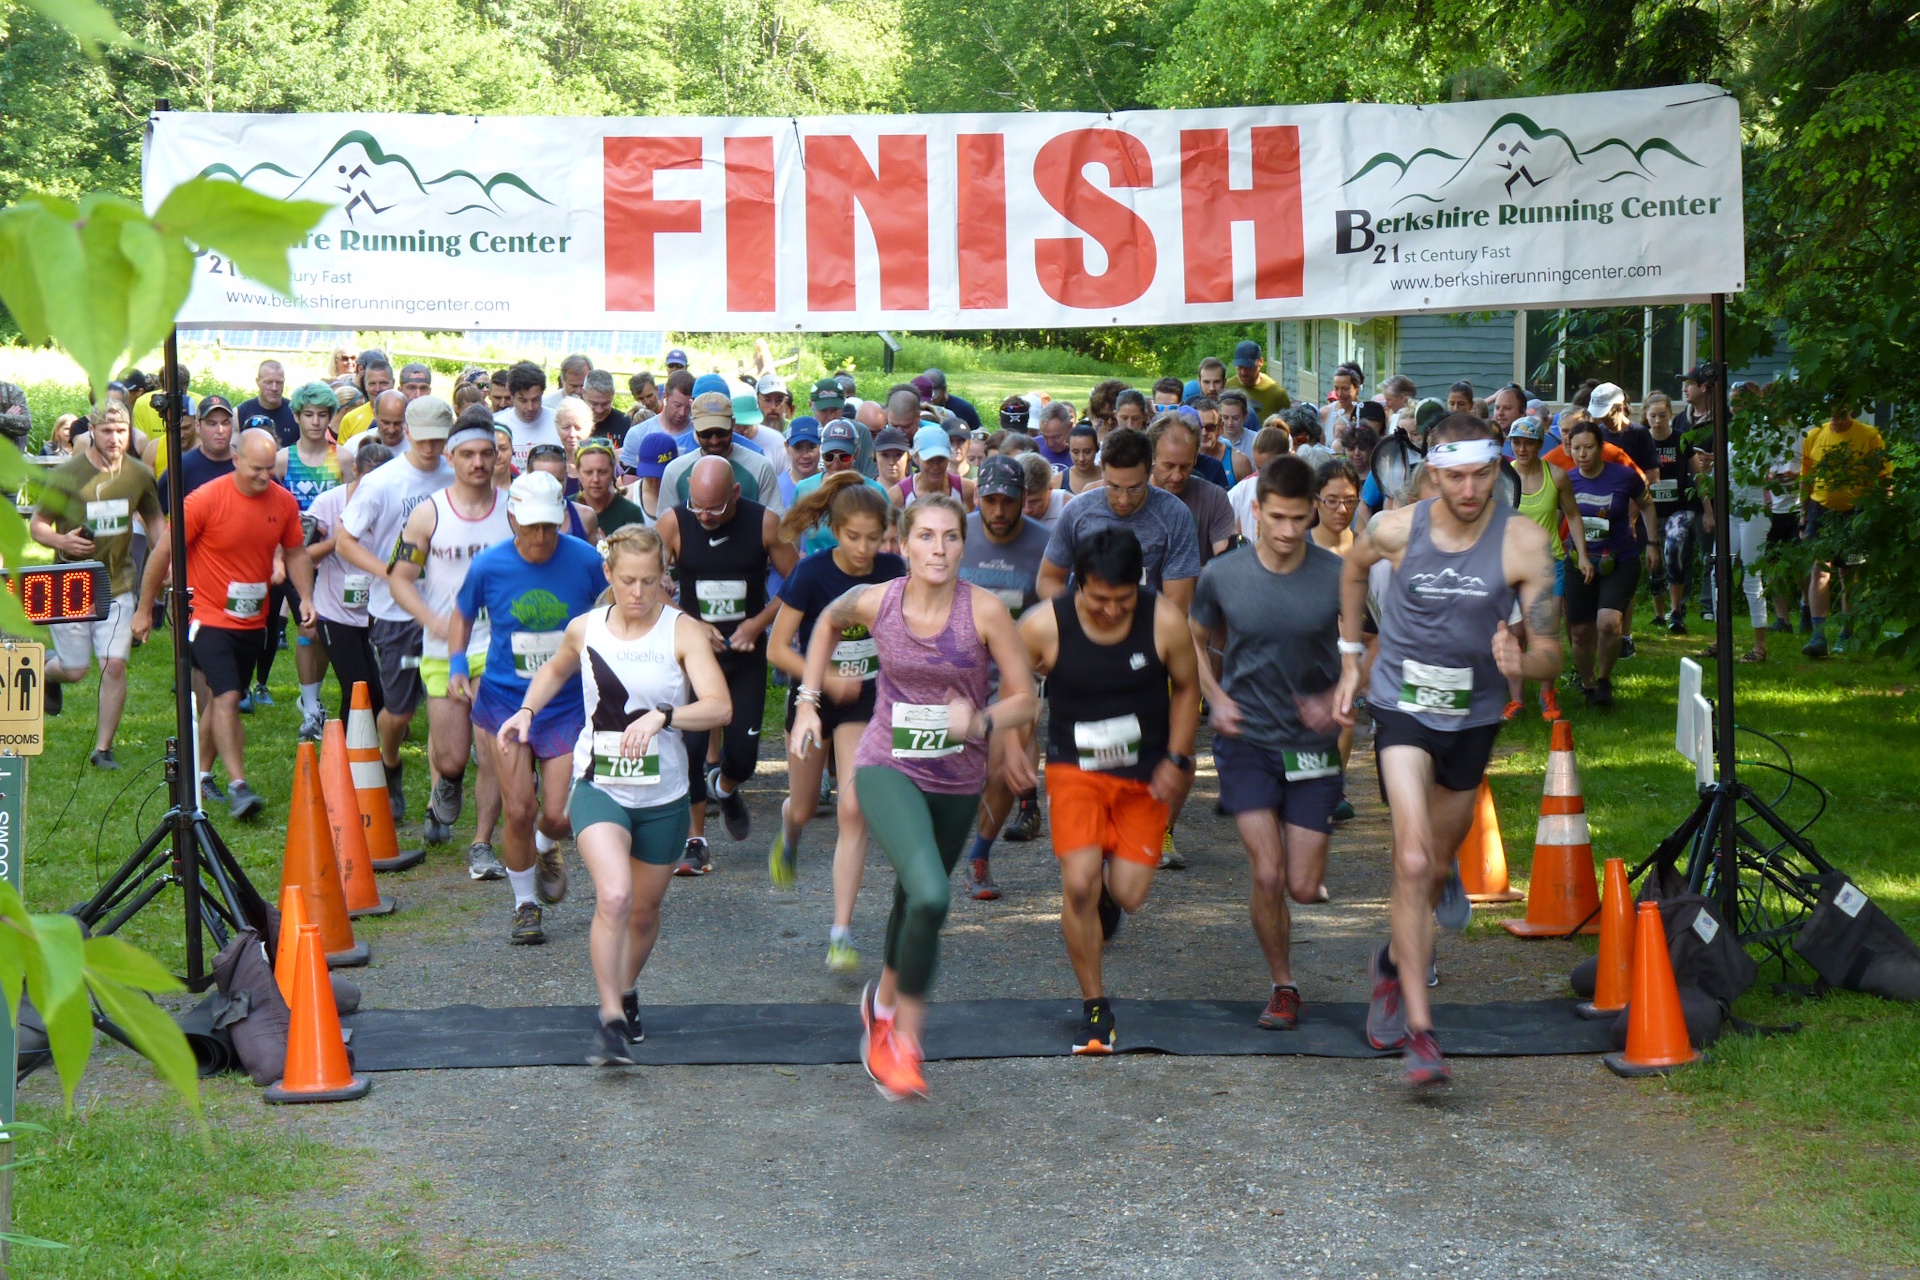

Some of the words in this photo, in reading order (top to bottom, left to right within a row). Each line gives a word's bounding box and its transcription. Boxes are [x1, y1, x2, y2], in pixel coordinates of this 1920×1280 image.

[603, 125, 1304, 312] FINISH
[1335, 207, 1490, 255] Berkshire
[1498, 198, 1613, 225] Running
[1621, 193, 1722, 219] Center
[340, 230, 462, 258] Running
[469, 230, 572, 254] Center
[1372, 243, 1400, 266] 21
[1420, 246, 1478, 266] Century
[1481, 245, 1511, 260] Fast
[323, 269, 353, 284] Fast
[1390, 263, 1662, 292] www.berkshirerunningcenter.com
[226, 290, 510, 314] www.berkshirerunningcenter.com
[707, 599, 736, 614] 724
[838, 658, 869, 677] 850
[908, 729, 948, 750] 727
[607, 756, 645, 777] 702
